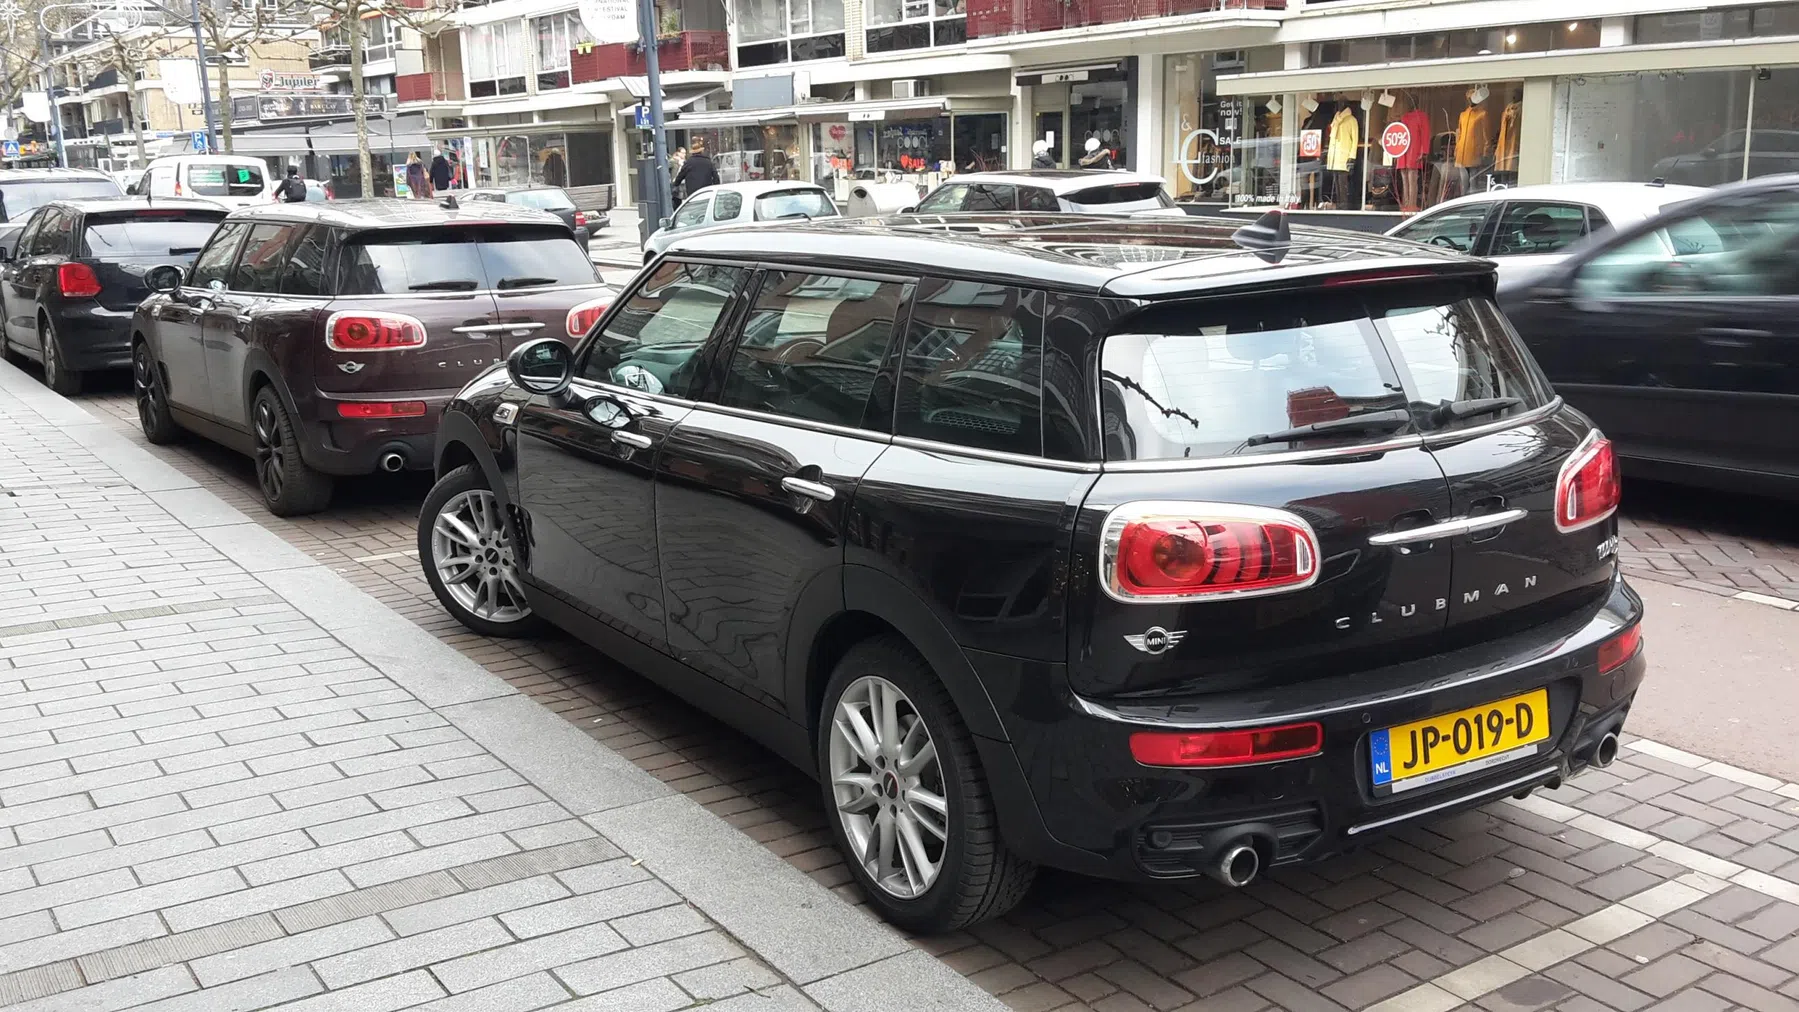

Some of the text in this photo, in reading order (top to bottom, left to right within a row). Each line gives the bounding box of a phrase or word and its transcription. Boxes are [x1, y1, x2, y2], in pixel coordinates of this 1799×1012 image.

[275, 76, 320, 88] Jupiler
[642, 106, 650, 118] P
[194, 132, 202, 143] P
[1386, 131, 1408, 147] 50%
[908, 158, 926, 169] SALE
[1202, 152, 1236, 164] fashion
[1334, 575, 1537, 630] CLUBMAN
[1146, 637, 1166, 646] MINI
[1403, 702, 1534, 769] JP-019-D
[1375, 761, 1389, 775] NL
